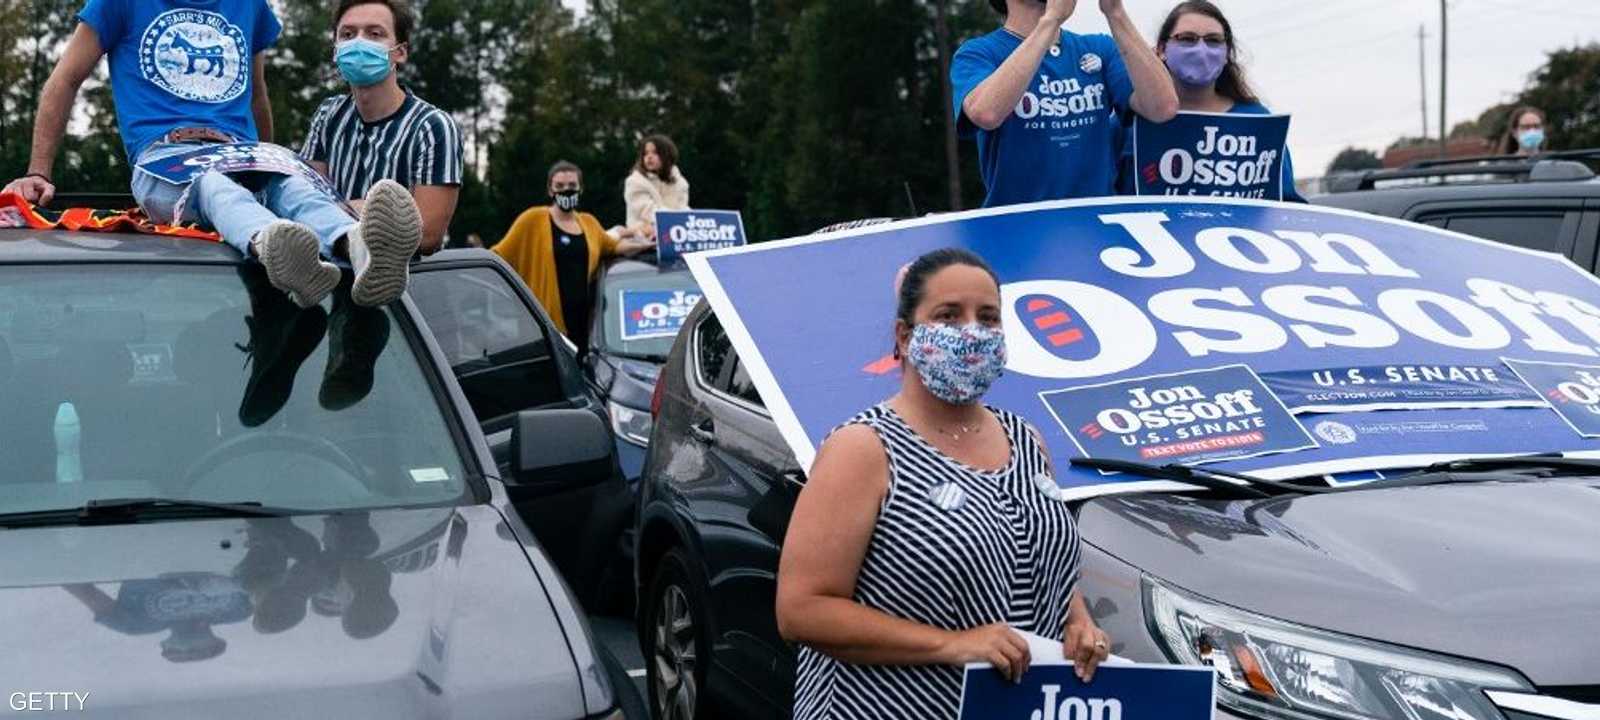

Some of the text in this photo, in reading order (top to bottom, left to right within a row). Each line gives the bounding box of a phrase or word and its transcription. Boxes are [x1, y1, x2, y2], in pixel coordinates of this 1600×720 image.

[1039, 74, 1081, 96] Jon
[1015, 83, 1104, 119] Ossoff
[1196, 125, 1256, 155] Jon
[1159, 148, 1277, 187] Ossoff
[555, 193, 579, 210] VOTE
[669, 224, 737, 243] Ossoff
[685, 215, 717, 229] Jon
[1098, 212, 1421, 279] Jon
[1312, 366, 1499, 386] U.S. SENATE
[1096, 389, 1263, 434] Ossoff
[1128, 386, 1207, 409] Jon
[1120, 416, 1266, 447] U.S. SENATE
[1031, 685, 1122, 720] Jon
